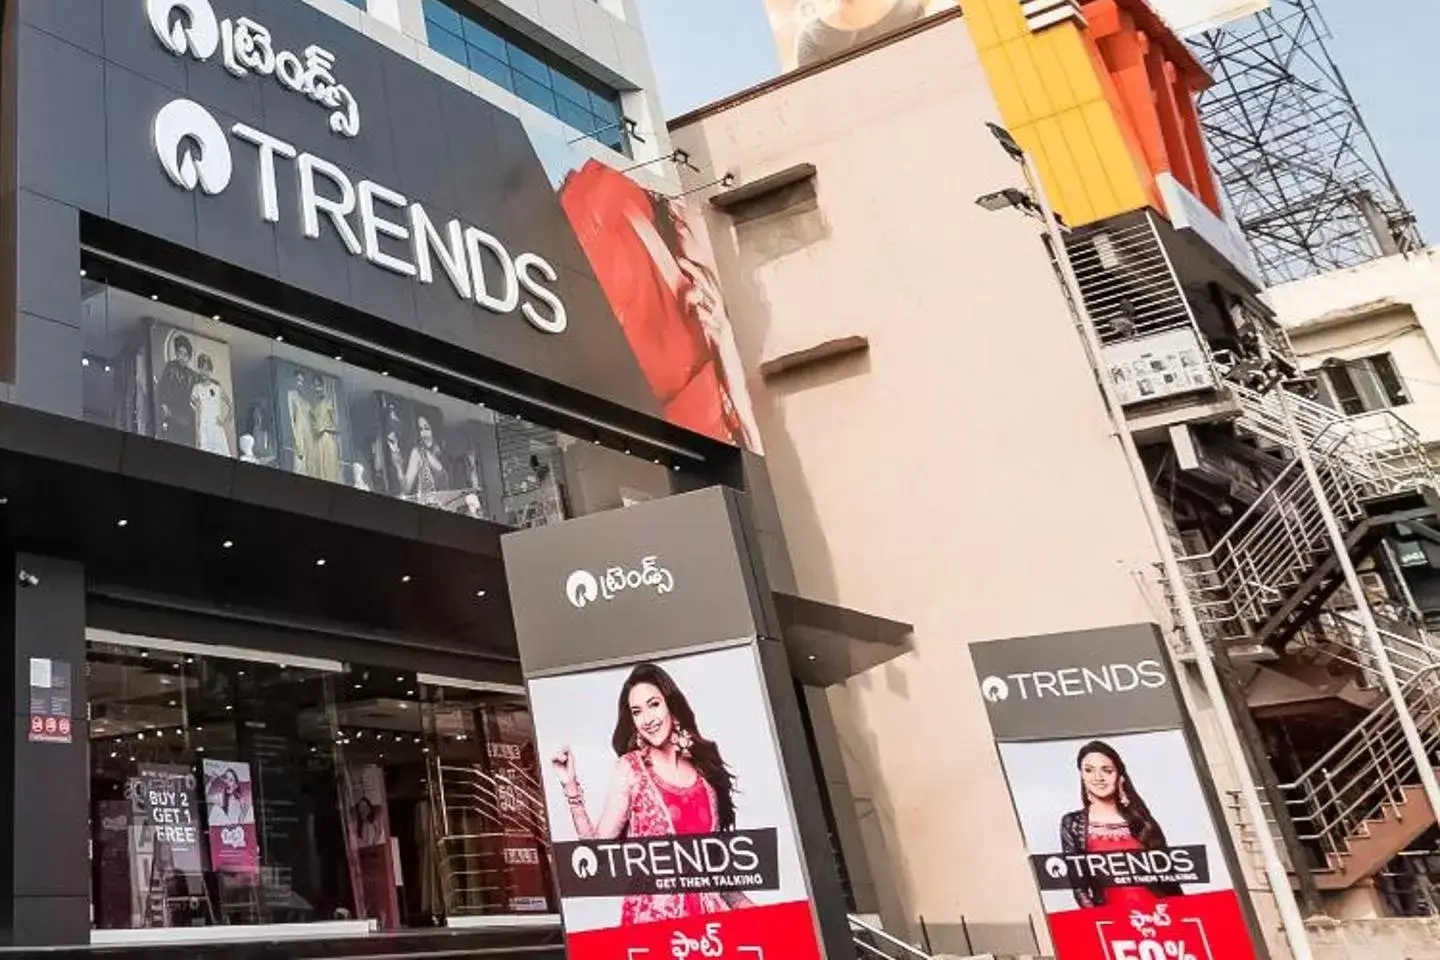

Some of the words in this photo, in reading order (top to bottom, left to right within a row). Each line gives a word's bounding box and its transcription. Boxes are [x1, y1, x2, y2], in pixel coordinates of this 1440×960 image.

[231, 121, 567, 334] TRENDS
[1007, 659, 1166, 700] TRENDS
[149, 791, 176, 806] BUY
[180, 792, 189, 807] 2
[152, 807, 180, 823] GET
[184, 809, 192, 824] 1
[156, 825, 196, 842] FREE
[596, 836, 760, 878] TRENDS
[1065, 850, 1195, 878] TRENDS
[656, 878, 677, 889] GET
[712, 873, 763, 886] TALKING
